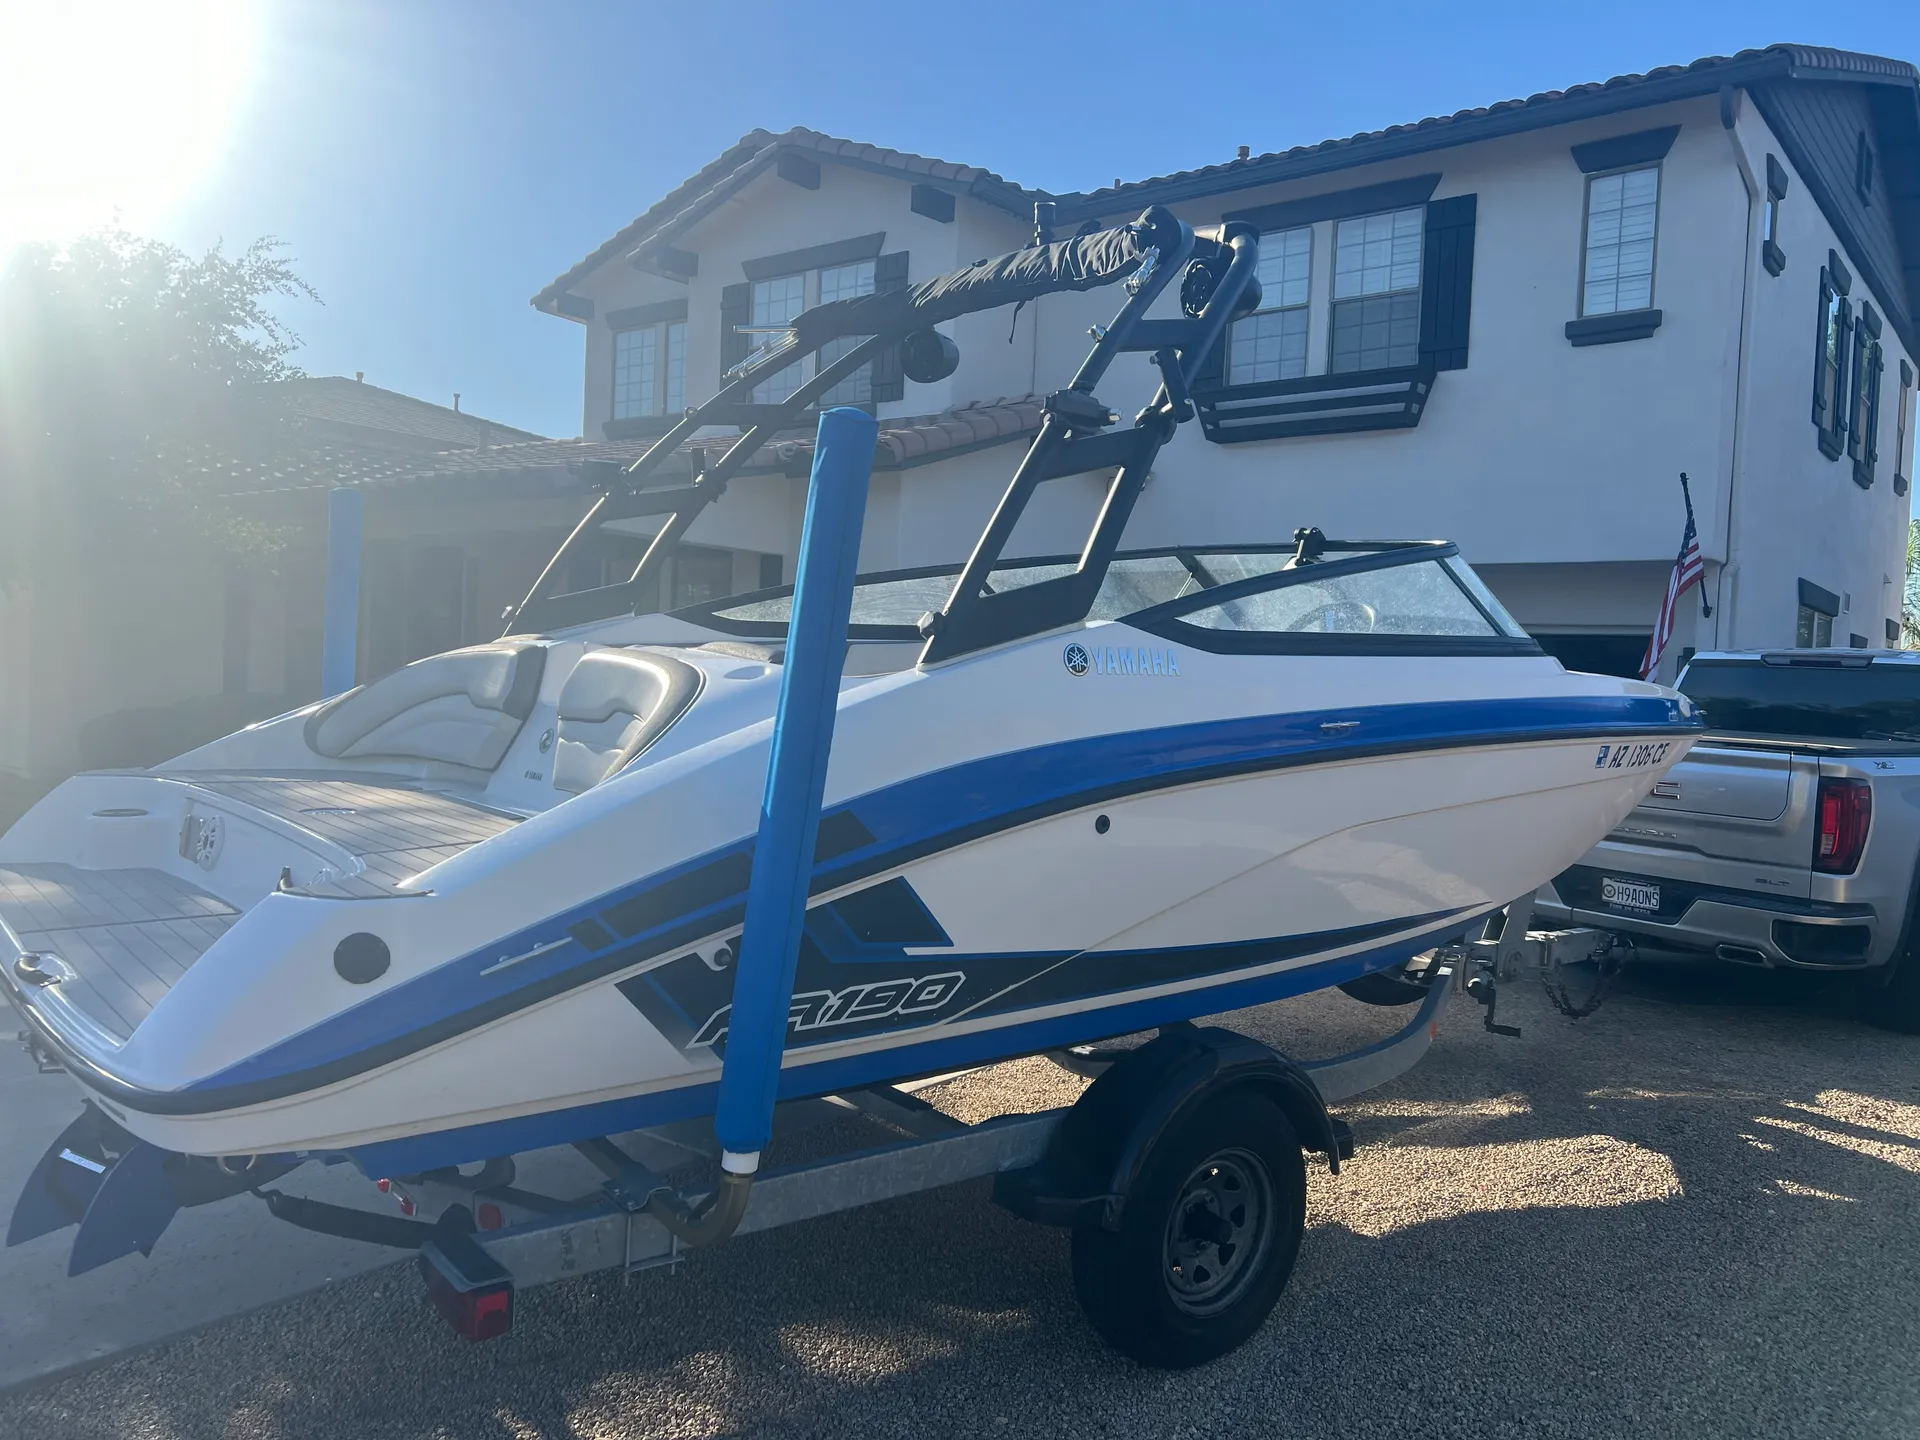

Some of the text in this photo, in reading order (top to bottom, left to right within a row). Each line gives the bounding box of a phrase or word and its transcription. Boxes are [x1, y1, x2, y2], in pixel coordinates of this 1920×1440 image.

[1089, 645, 1181, 677] YAMAHA
[1608, 745, 1630, 768] AZ
[1652, 742, 1670, 764] CE
